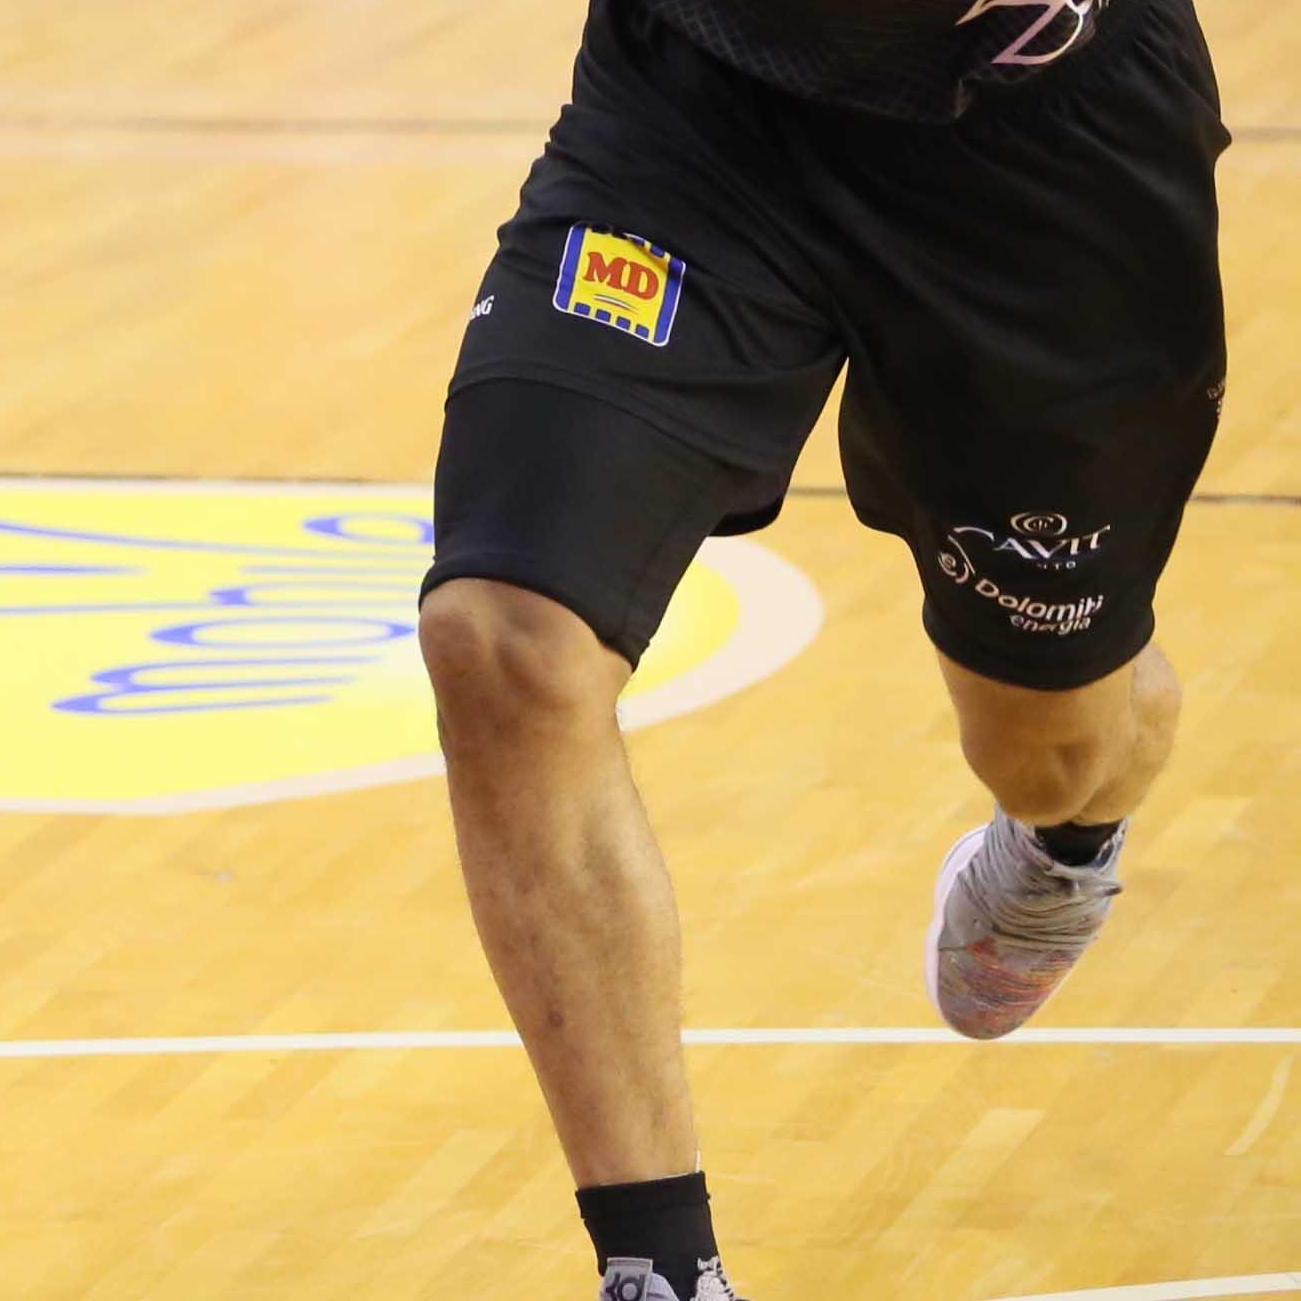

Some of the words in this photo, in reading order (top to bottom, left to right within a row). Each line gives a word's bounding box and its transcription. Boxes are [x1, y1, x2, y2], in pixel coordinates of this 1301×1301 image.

[584, 251, 660, 302] MD
[975, 578, 1104, 622] Dolomiti
[1009, 613, 1091, 635] energia
